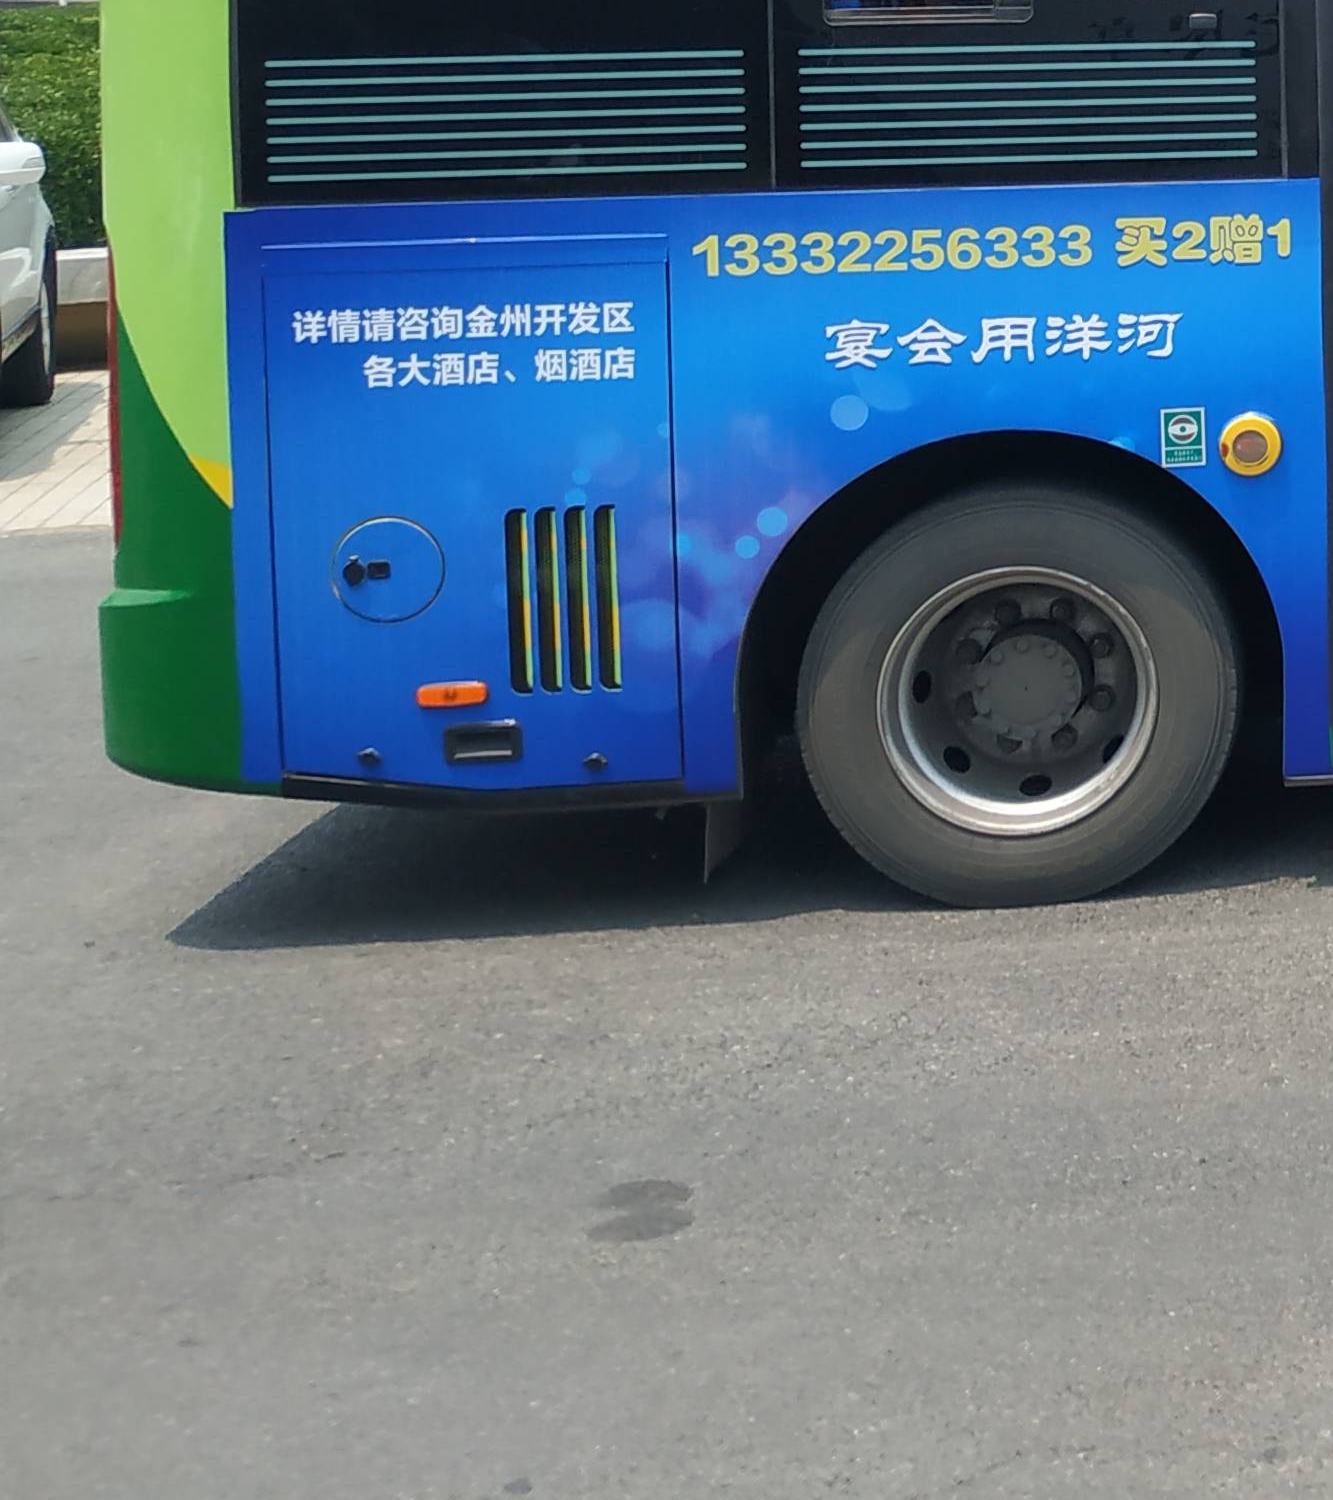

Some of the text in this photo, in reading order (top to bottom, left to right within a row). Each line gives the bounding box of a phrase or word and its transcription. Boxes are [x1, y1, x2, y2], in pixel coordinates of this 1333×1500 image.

[692, 214, 1292, 277] 13332256333 买2赠1
[292, 302, 635, 344] 详情请咨询金州开发区
[824, 311, 1183, 369] 宴会用洋河
[363, 347, 635, 388] 各大酒店、烟酒店
